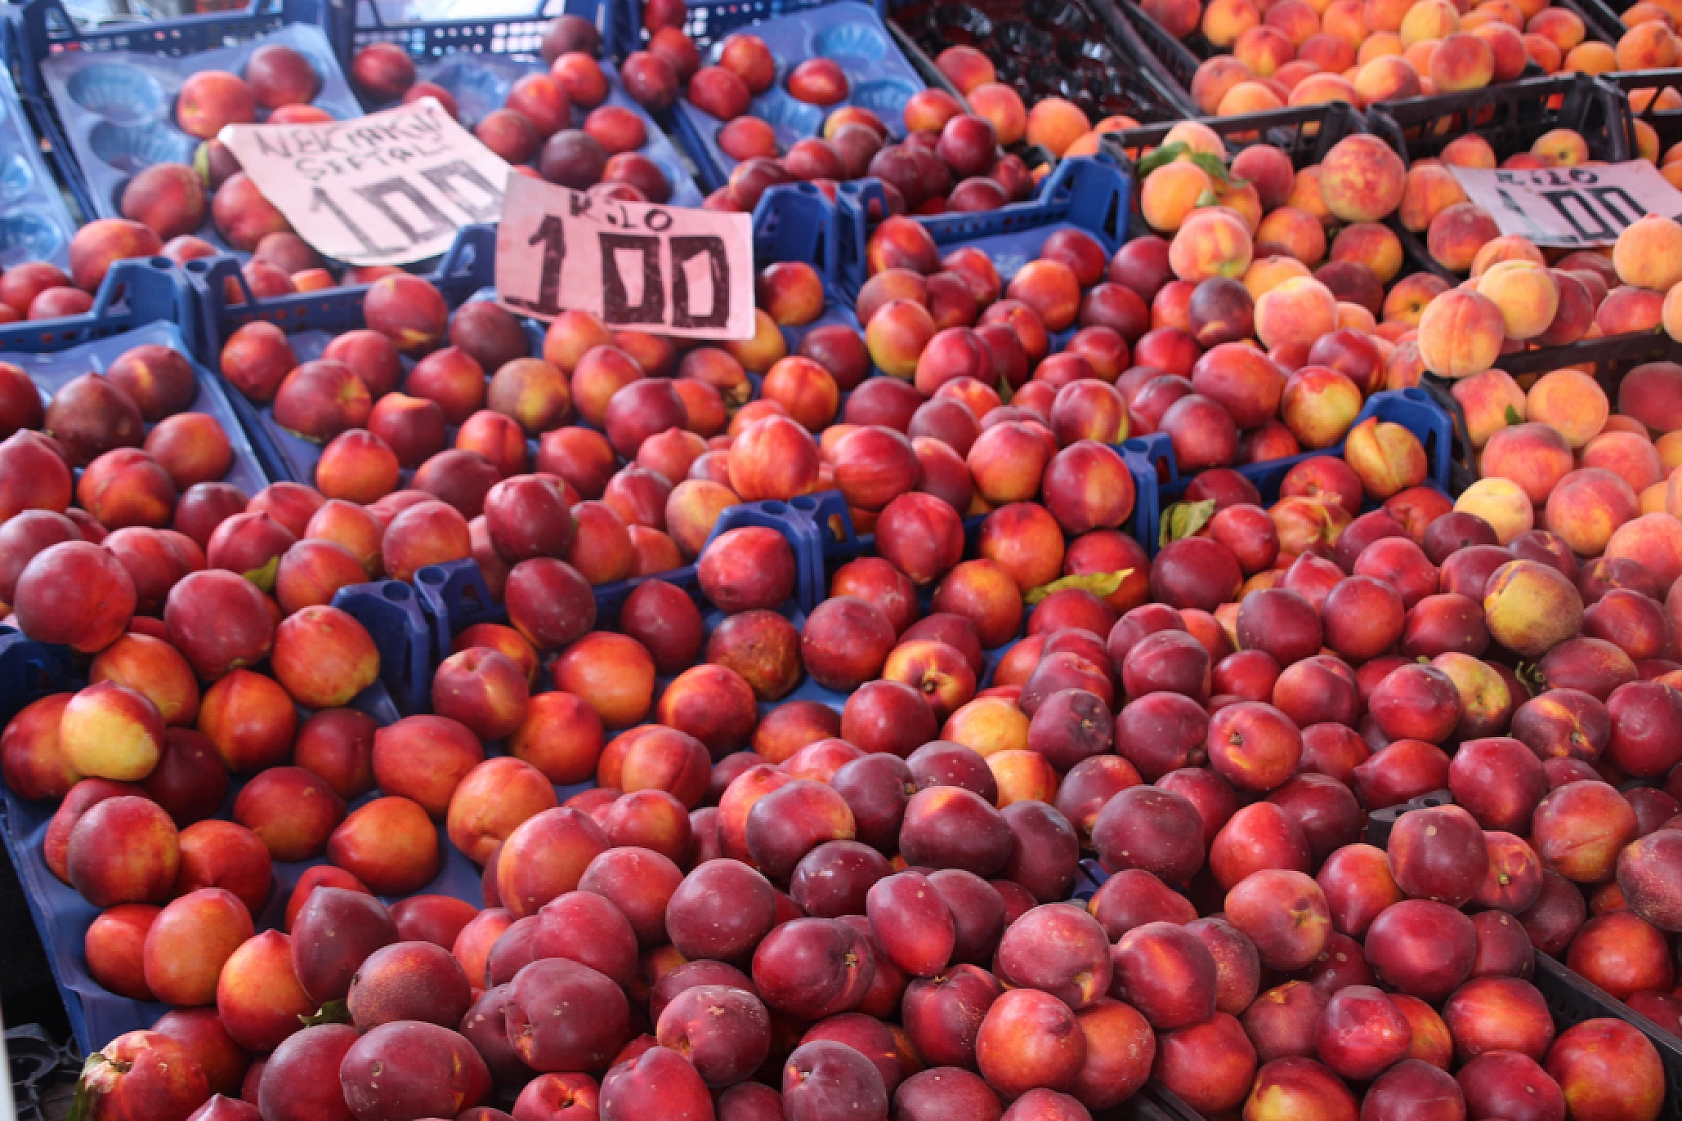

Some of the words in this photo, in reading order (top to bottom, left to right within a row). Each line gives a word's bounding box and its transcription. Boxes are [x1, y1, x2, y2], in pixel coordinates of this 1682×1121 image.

[309, 159, 502, 255] 100
[1495, 186, 1648, 244] 100
[503, 214, 730, 329] 100
